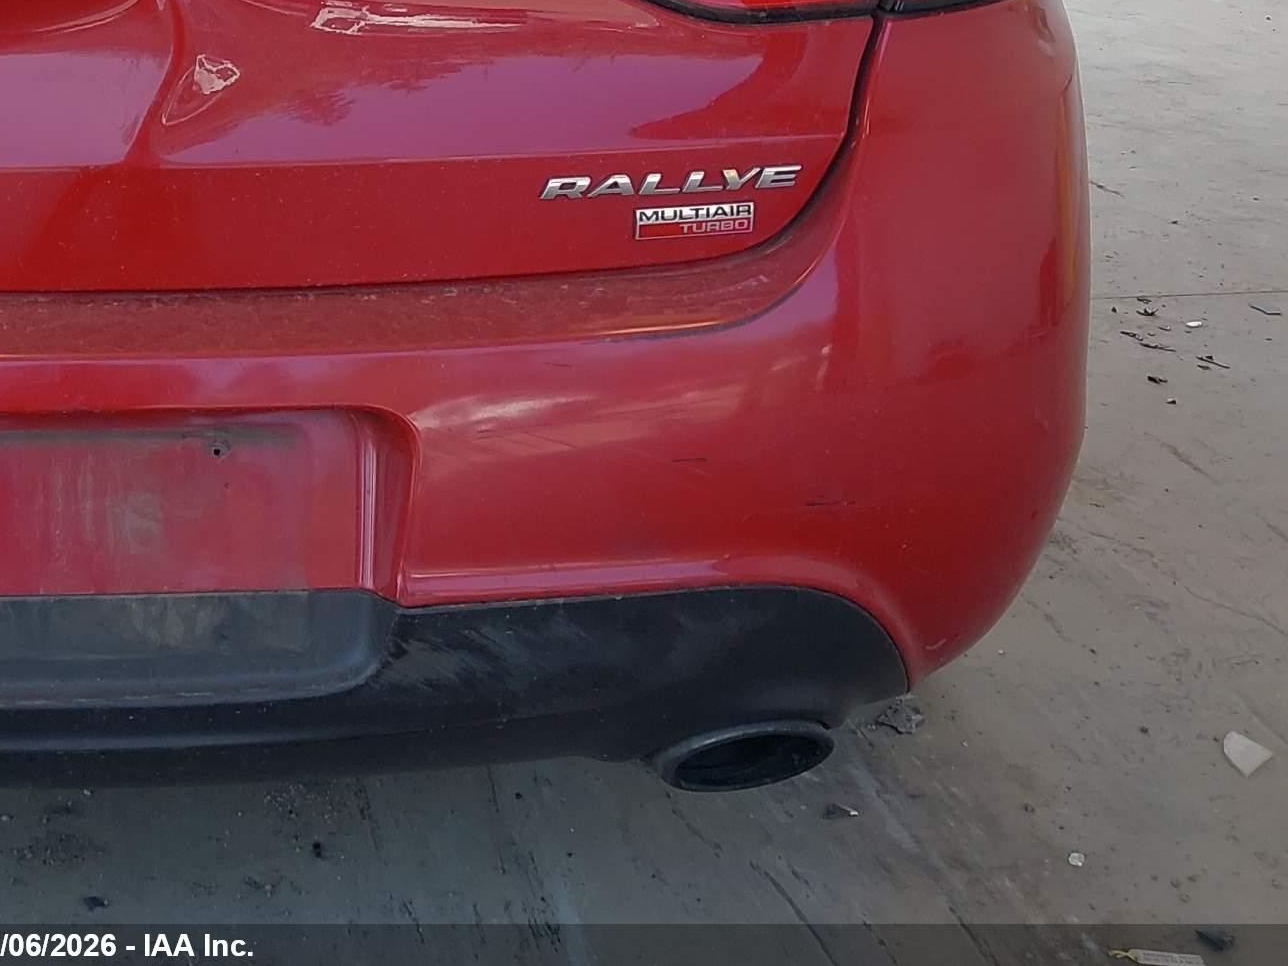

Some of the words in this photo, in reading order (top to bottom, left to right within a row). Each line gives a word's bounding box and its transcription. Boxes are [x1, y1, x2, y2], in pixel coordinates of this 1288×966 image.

[539, 165, 802, 200] RALLYE
[639, 204, 752, 222] MULTIAIR
[680, 219, 748, 234] TURBO
